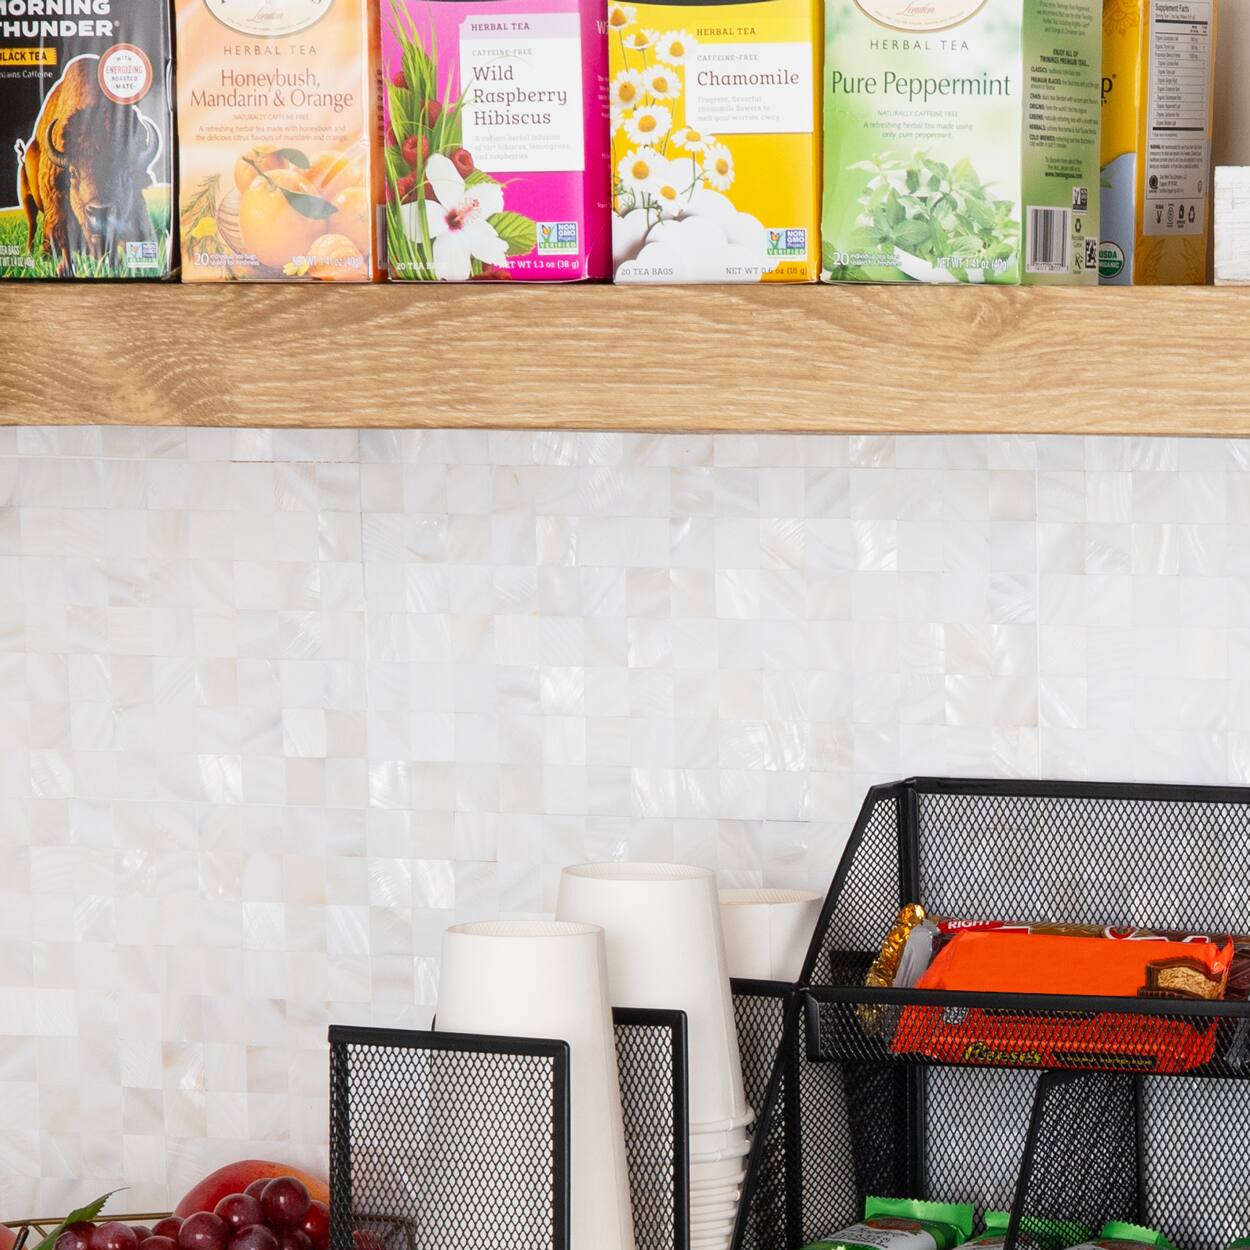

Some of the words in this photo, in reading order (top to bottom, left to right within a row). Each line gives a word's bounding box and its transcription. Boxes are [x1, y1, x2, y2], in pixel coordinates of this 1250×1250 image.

[0, 0, 110, 15] ORNING
[0, 20, 113, 37] HUNDER
[471, 23, 509, 32] HERBAL
[512, 22, 530, 31] TEA
[697, 28, 735, 36] HERBAL
[223, 45, 281, 56] HERBAL
[290, 45, 317, 56] TEA
[870, 40, 931, 50] HERBAL
[940, 40, 969, 50] TEA
[29, 51, 48, 61] TEA
[472, 48, 533, 57] CAFFEINE-FREE
[221, 68, 321, 91] Honeybush,
[473, 65, 514, 81] Wild
[697, 69, 800, 87] Chamomile
[832, 70, 877, 95] Pure
[884, 71, 1012, 102] Peppermint
[190, 89, 268, 108] Mandarin
[273, 90, 286, 107] &
[290, 90, 353, 113] Orange
[473, 87, 568, 107] Raspberry
[474, 110, 552, 126] Hibiscus
[194, 253, 209, 266] 20
[833, 252, 849, 266] 20
[1099, 251, 1118, 259] USDA
[518, 261, 531, 269] WT
[533, 260, 544, 269] 1.3
[725, 267, 742, 275] NET
[745, 267, 759, 275] WT
[621, 268, 631, 276] 20
[633, 268, 650, 276] TEA
[652, 267, 673, 276] BAGS
